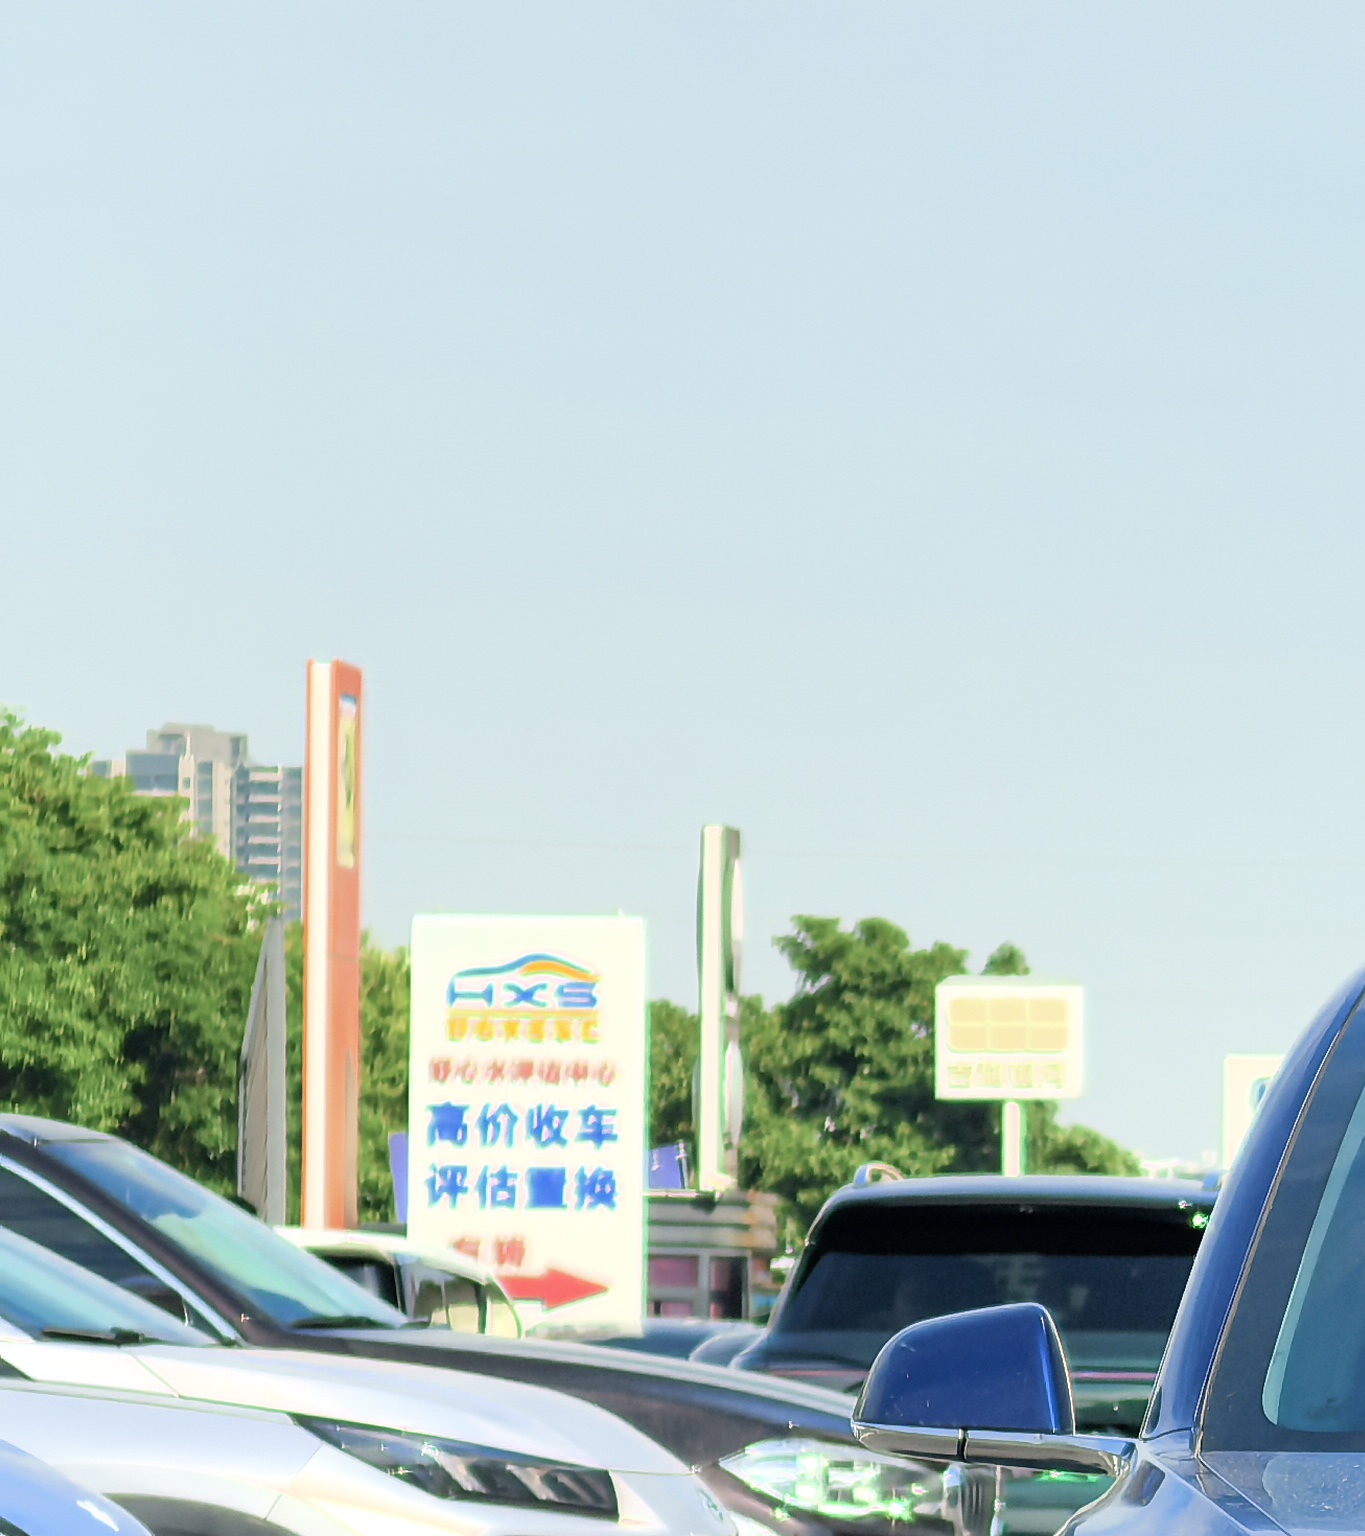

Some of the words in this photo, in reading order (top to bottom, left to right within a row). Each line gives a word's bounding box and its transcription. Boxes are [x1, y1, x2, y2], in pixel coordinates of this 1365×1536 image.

[447, 981, 598, 1008] HXS
[425, 1102, 619, 1148] 高价收车
[425, 1165, 619, 1210] 评估置换
